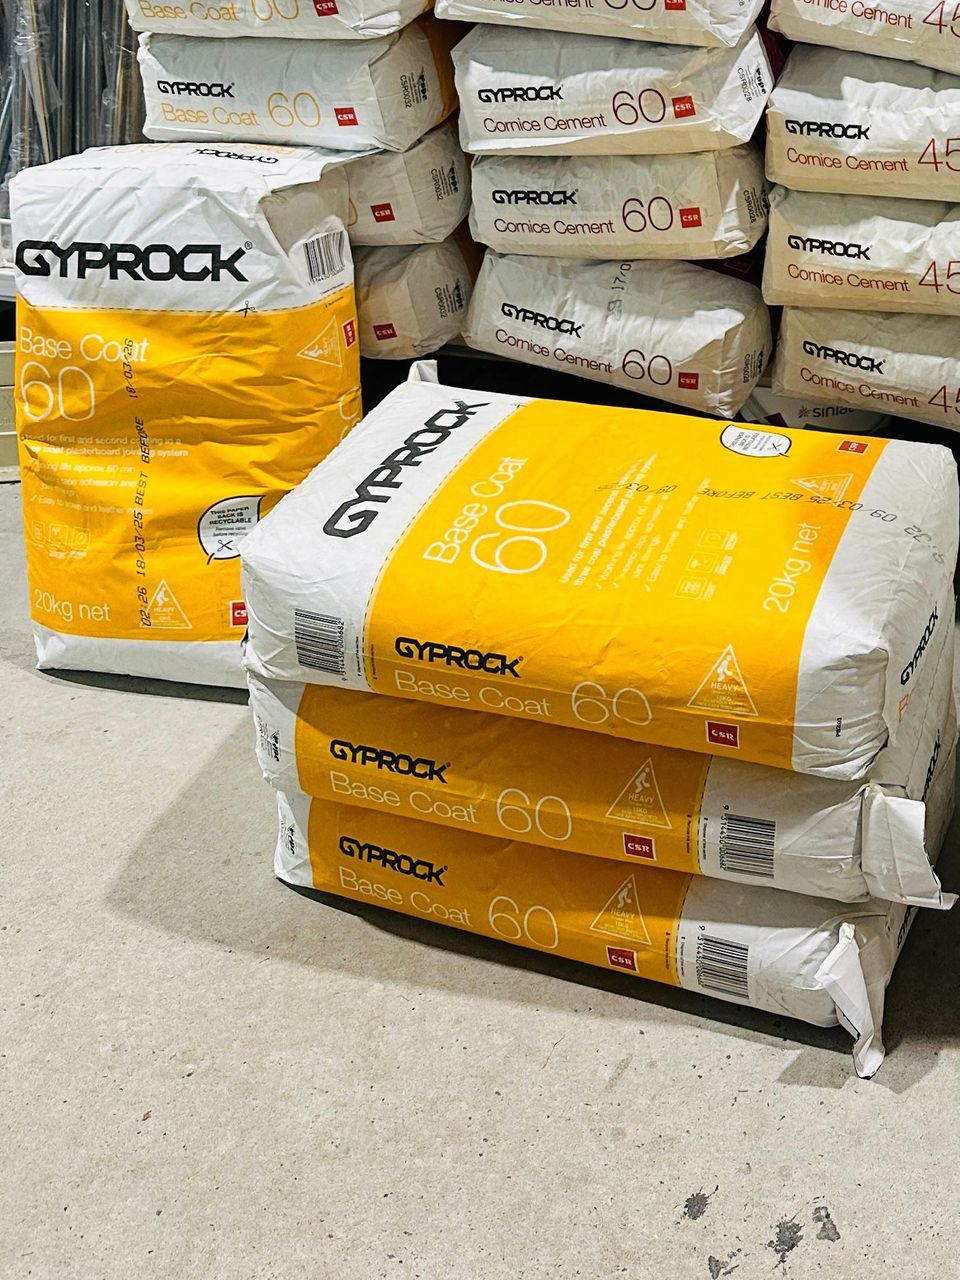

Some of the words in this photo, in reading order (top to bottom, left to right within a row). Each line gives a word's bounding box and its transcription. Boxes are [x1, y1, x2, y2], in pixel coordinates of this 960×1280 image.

[138, 0, 184, 19] Base
[157, 81, 235, 98] GYPROCK
[267, 92, 320, 128] 60
[612, 89, 666, 125] 60
[492, 190, 577, 205] GYPROCK
[494, 219, 551, 234] Cornice
[553, 220, 615, 235] Cement
[622, 196, 673, 232] 60
[15, 239, 249, 282] GYPROCK
[19, 326, 73, 360] Base
[622, 350, 672, 385] 60
[21, 361, 95, 421] 60
[136, 416, 151, 465] BEFORE
[135, 472, 149, 506] BEST
[323, 399, 491, 539] GYPROCK
[471, 457, 528, 498] Coat
[135, 509, 147, 577] 18/03/25
[470, 500, 571, 574] 60
[395, 636, 520, 678] GYPROCK
[479, 687, 552, 717] Coat
[571, 681, 652, 726] 60
[711, 729, 735, 741] CSR
[329, 738, 447, 784] GYPROCK
[329, 771, 401, 807] Base
[496, 787, 573, 842] 60
[338, 835, 447, 887] GYPROCK
[627, 842, 650, 853] CSR
[338, 866, 404, 906] Base
[410, 891, 471, 927] Coat
[488, 895, 560, 950] 60
[611, 955, 633, 968] CSR
